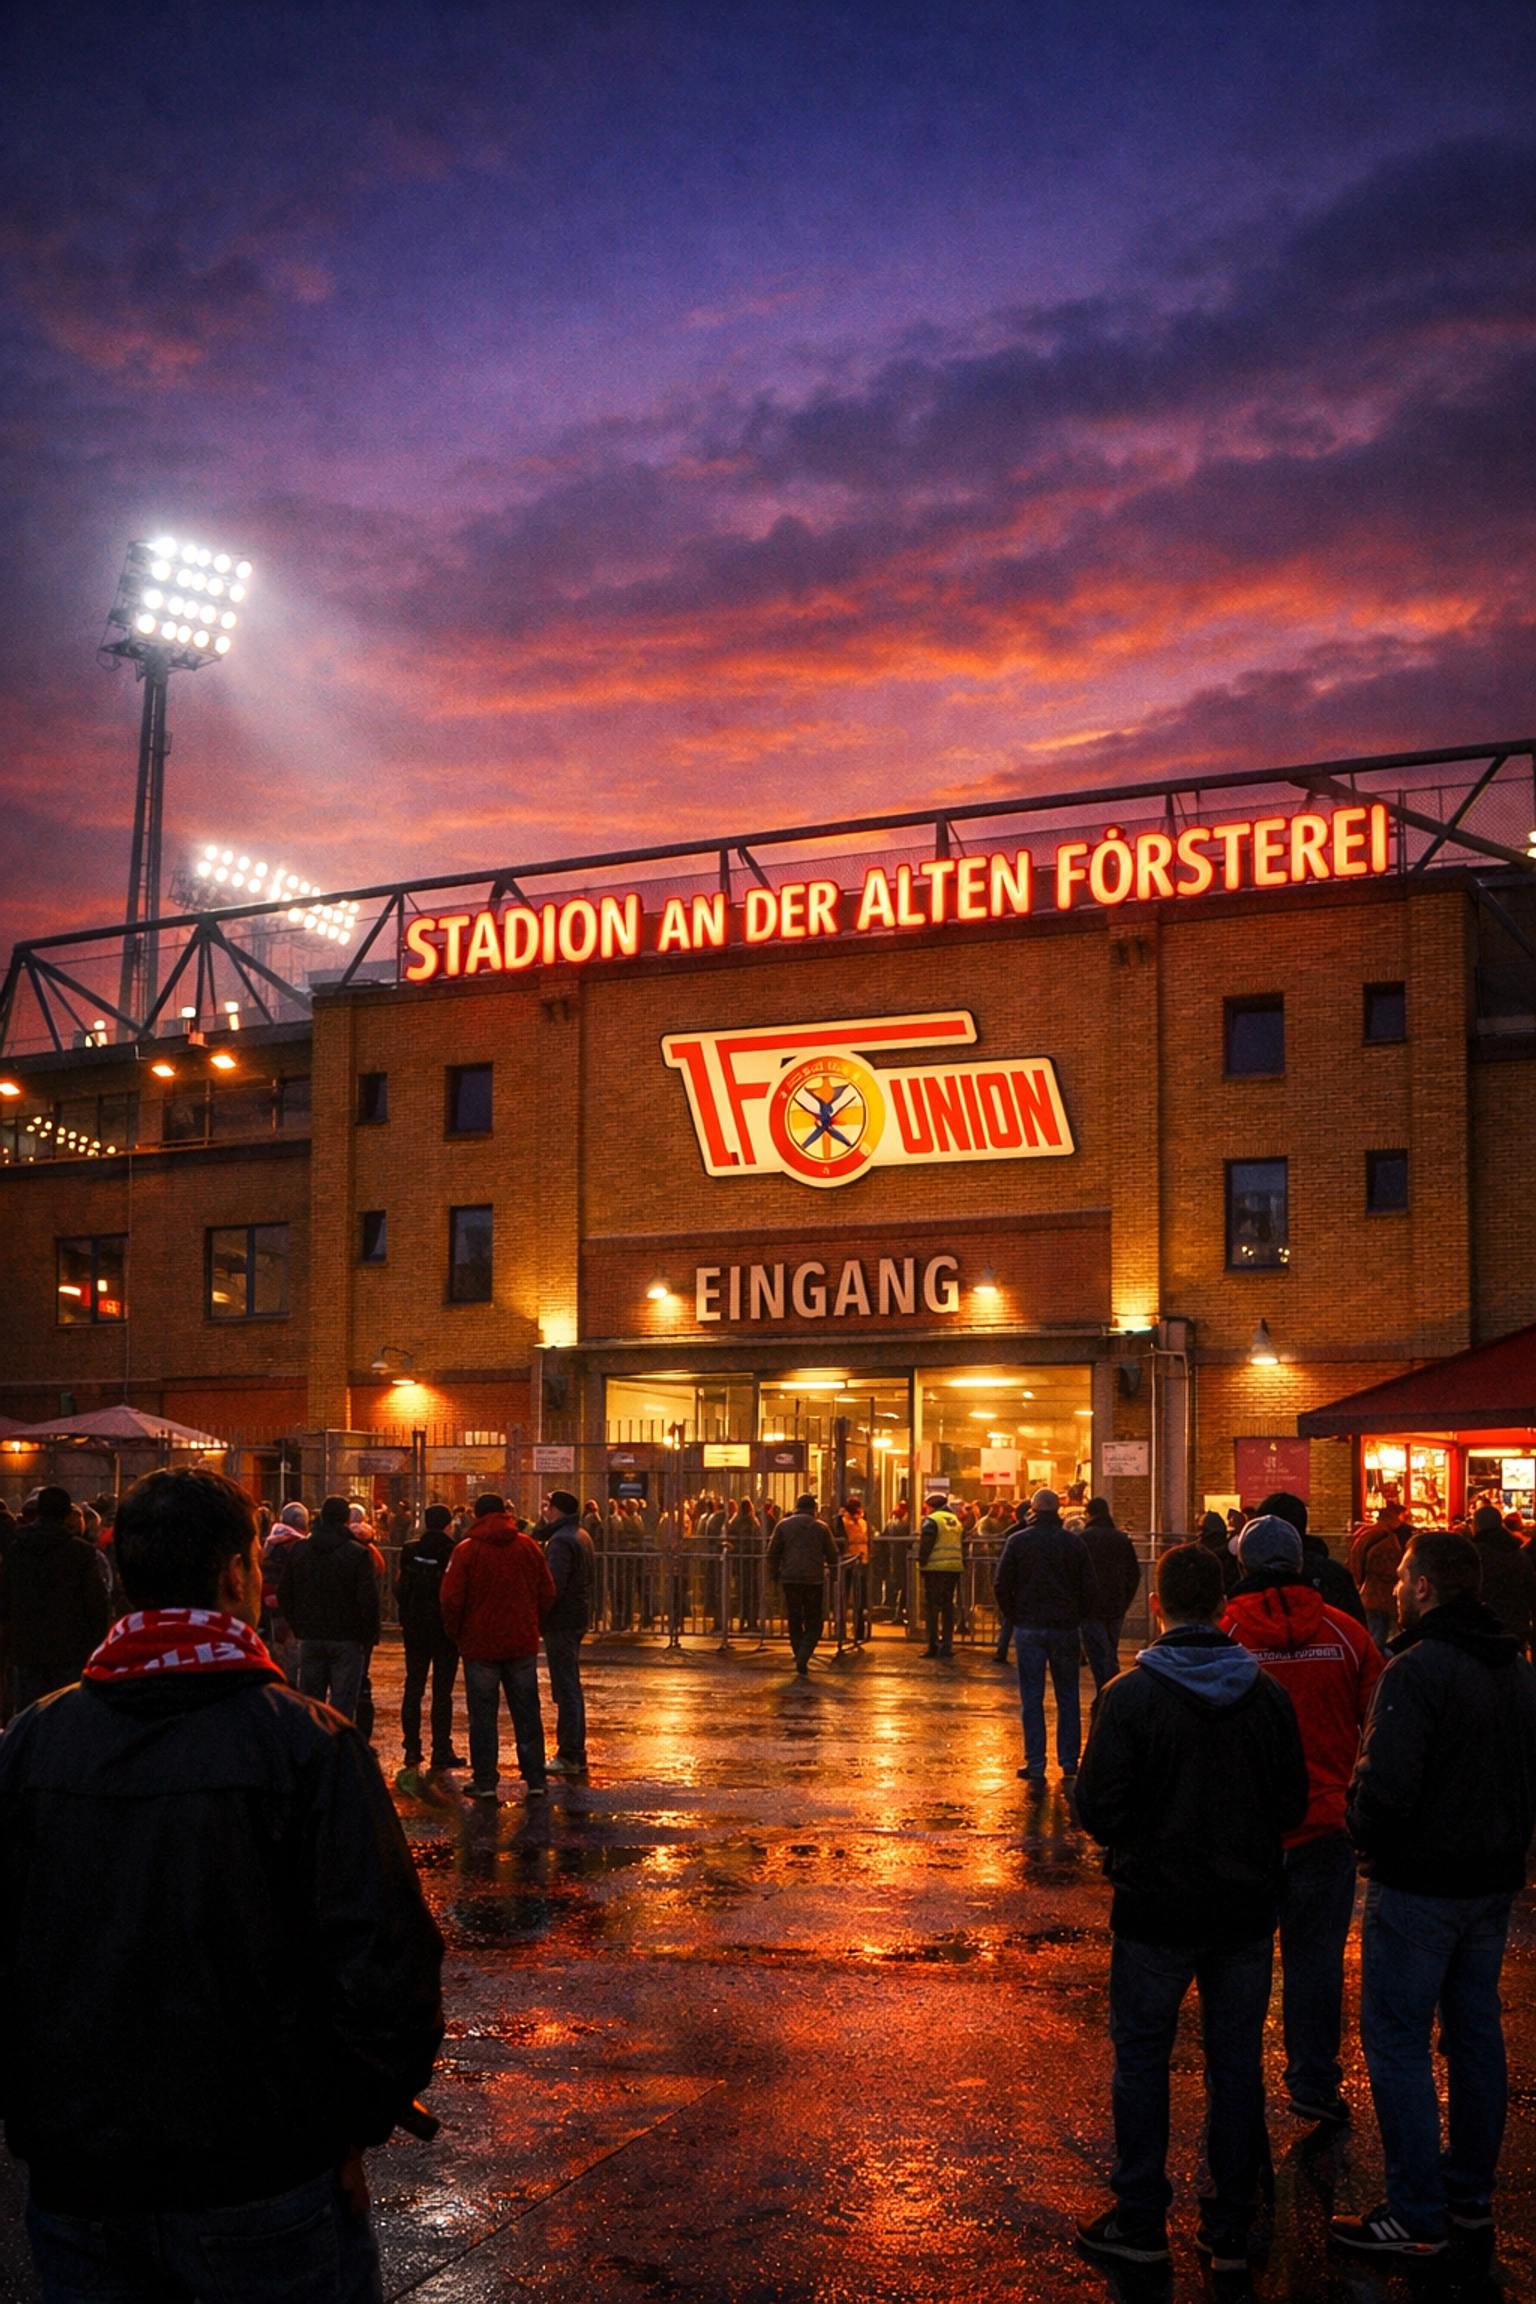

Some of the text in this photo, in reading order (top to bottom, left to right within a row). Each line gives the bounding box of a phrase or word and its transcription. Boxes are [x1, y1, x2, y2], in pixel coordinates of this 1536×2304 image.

[405, 893, 638, 981] STADION
[658, 896, 725, 952] AN
[745, 881, 839, 942] DER
[856, 850, 1031, 931] ALTEN
[889, 1069, 1062, 1154] UNION
[695, 1256, 960, 1323] EINGANG
